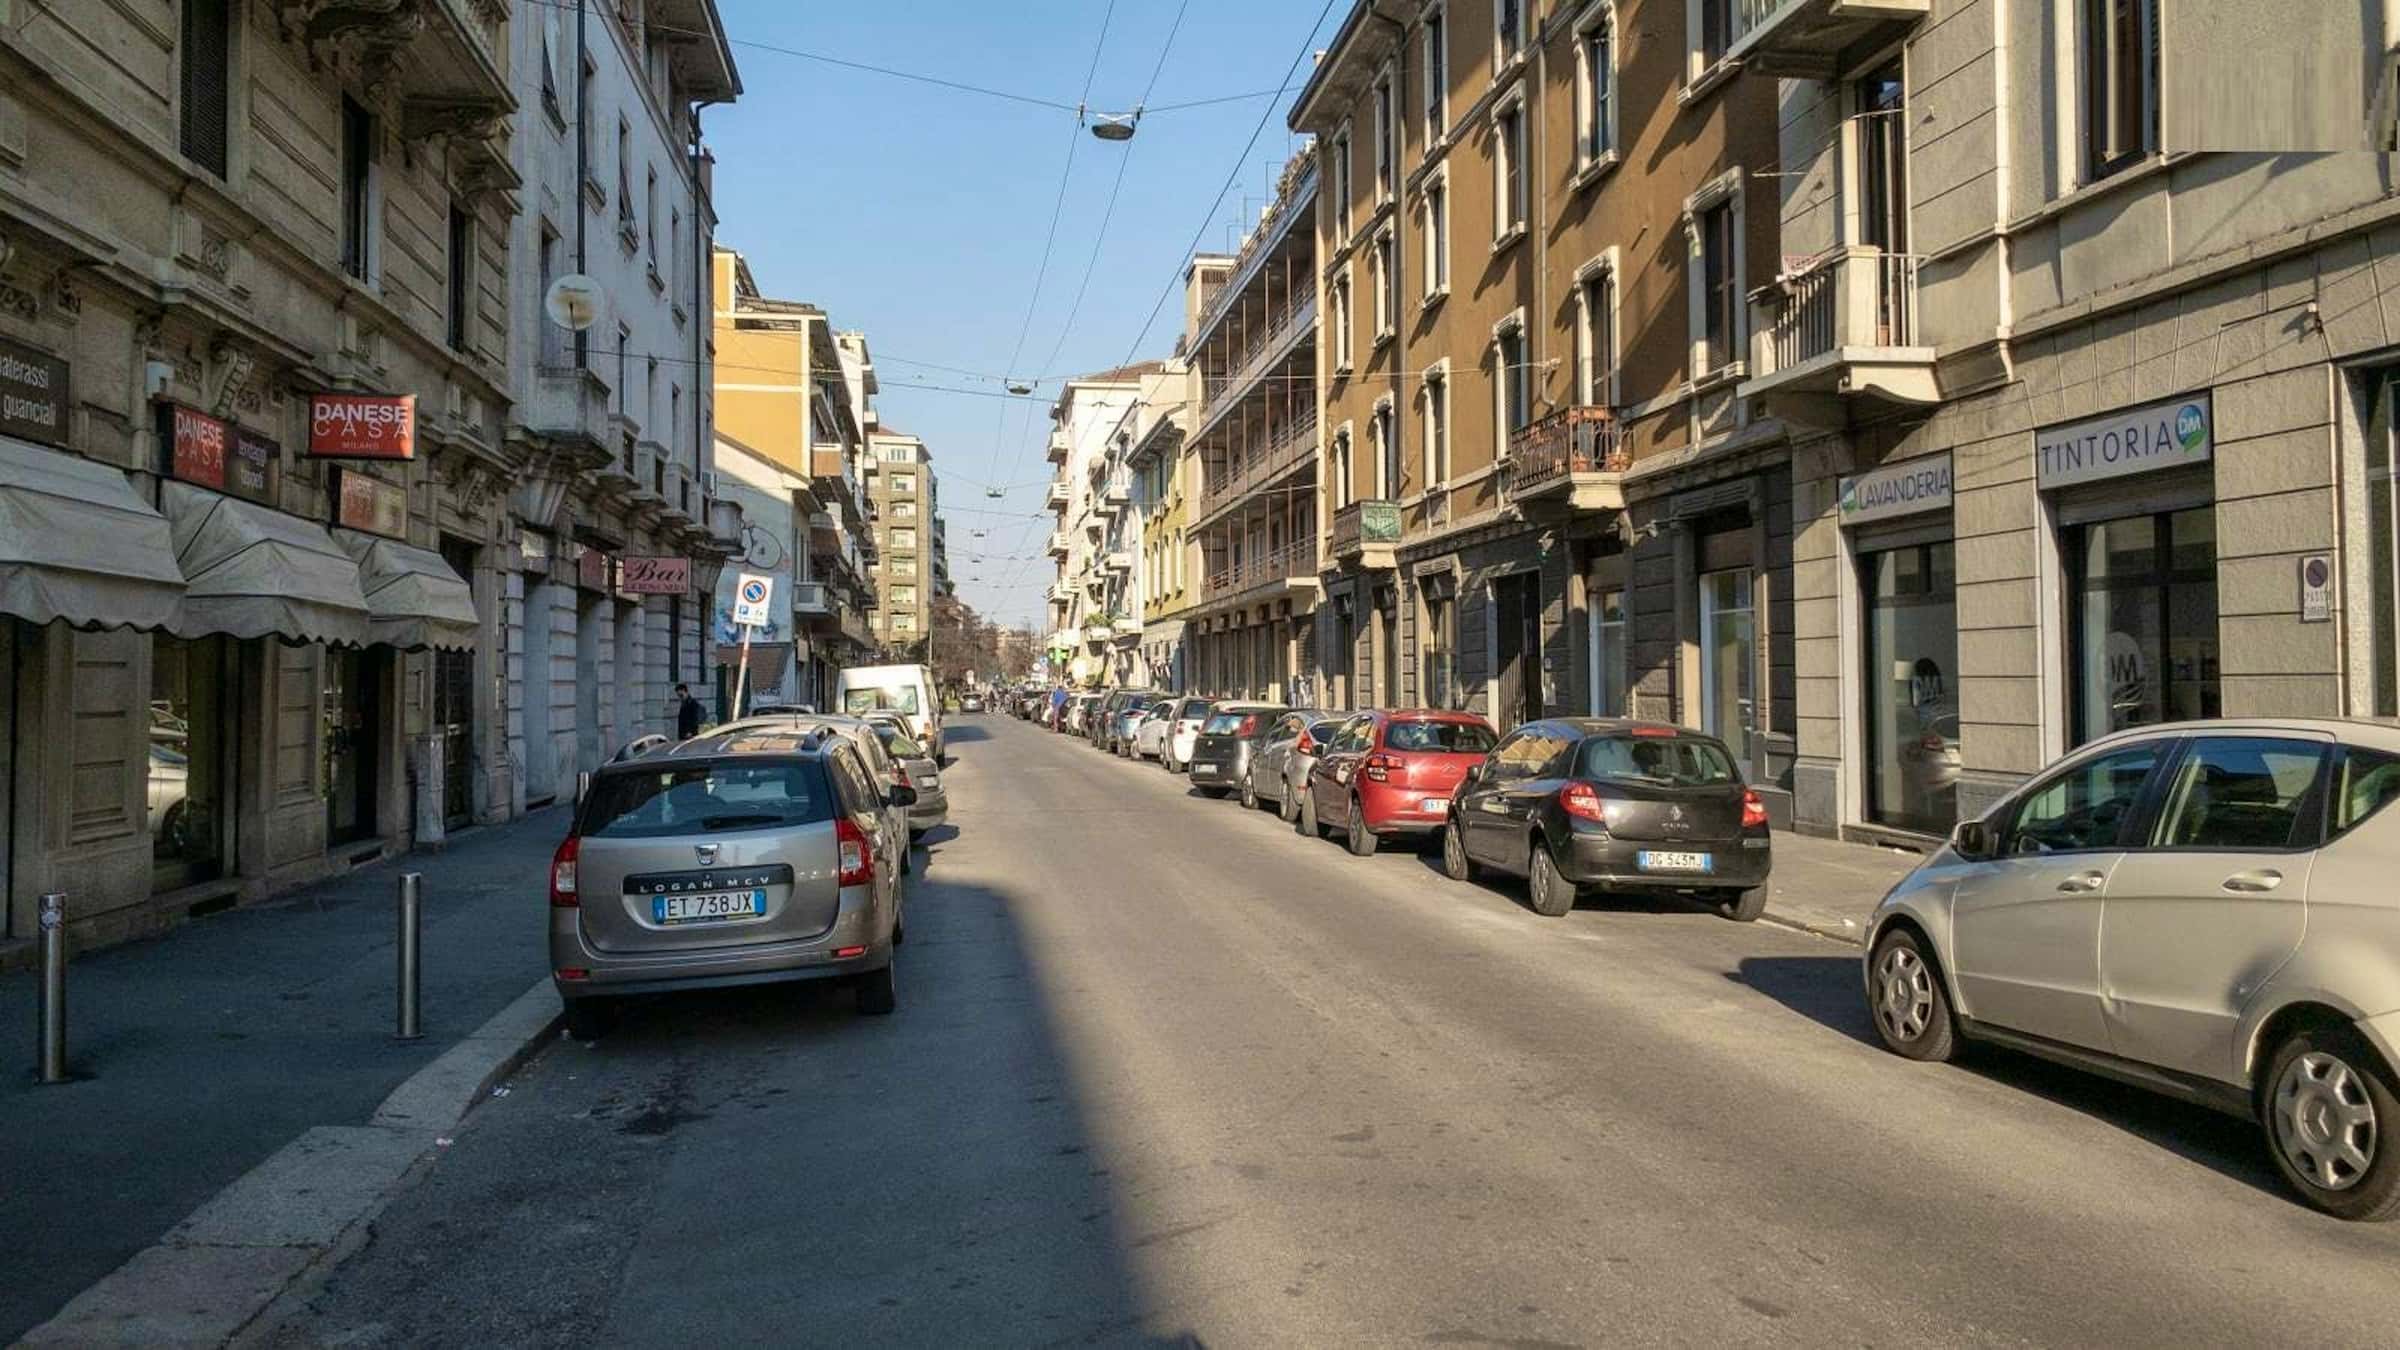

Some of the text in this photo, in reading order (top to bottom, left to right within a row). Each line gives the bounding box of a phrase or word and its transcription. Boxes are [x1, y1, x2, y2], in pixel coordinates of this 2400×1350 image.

[0, 354, 48, 389] aterassi
[315, 403, 409, 422] DANESE
[2178, 415, 2202, 433] DM
[175, 411, 223, 450] DANESE
[314, 421, 409, 438] CASA
[176, 433, 223, 469] CASA
[2041, 421, 2173, 475] TINTORIA
[1858, 468, 1951, 510] LAVANDERIA
[625, 560, 685, 581] Bar
[639, 876, 769, 894] LOGAN MCV
[667, 893, 753, 917] ET 738JX
